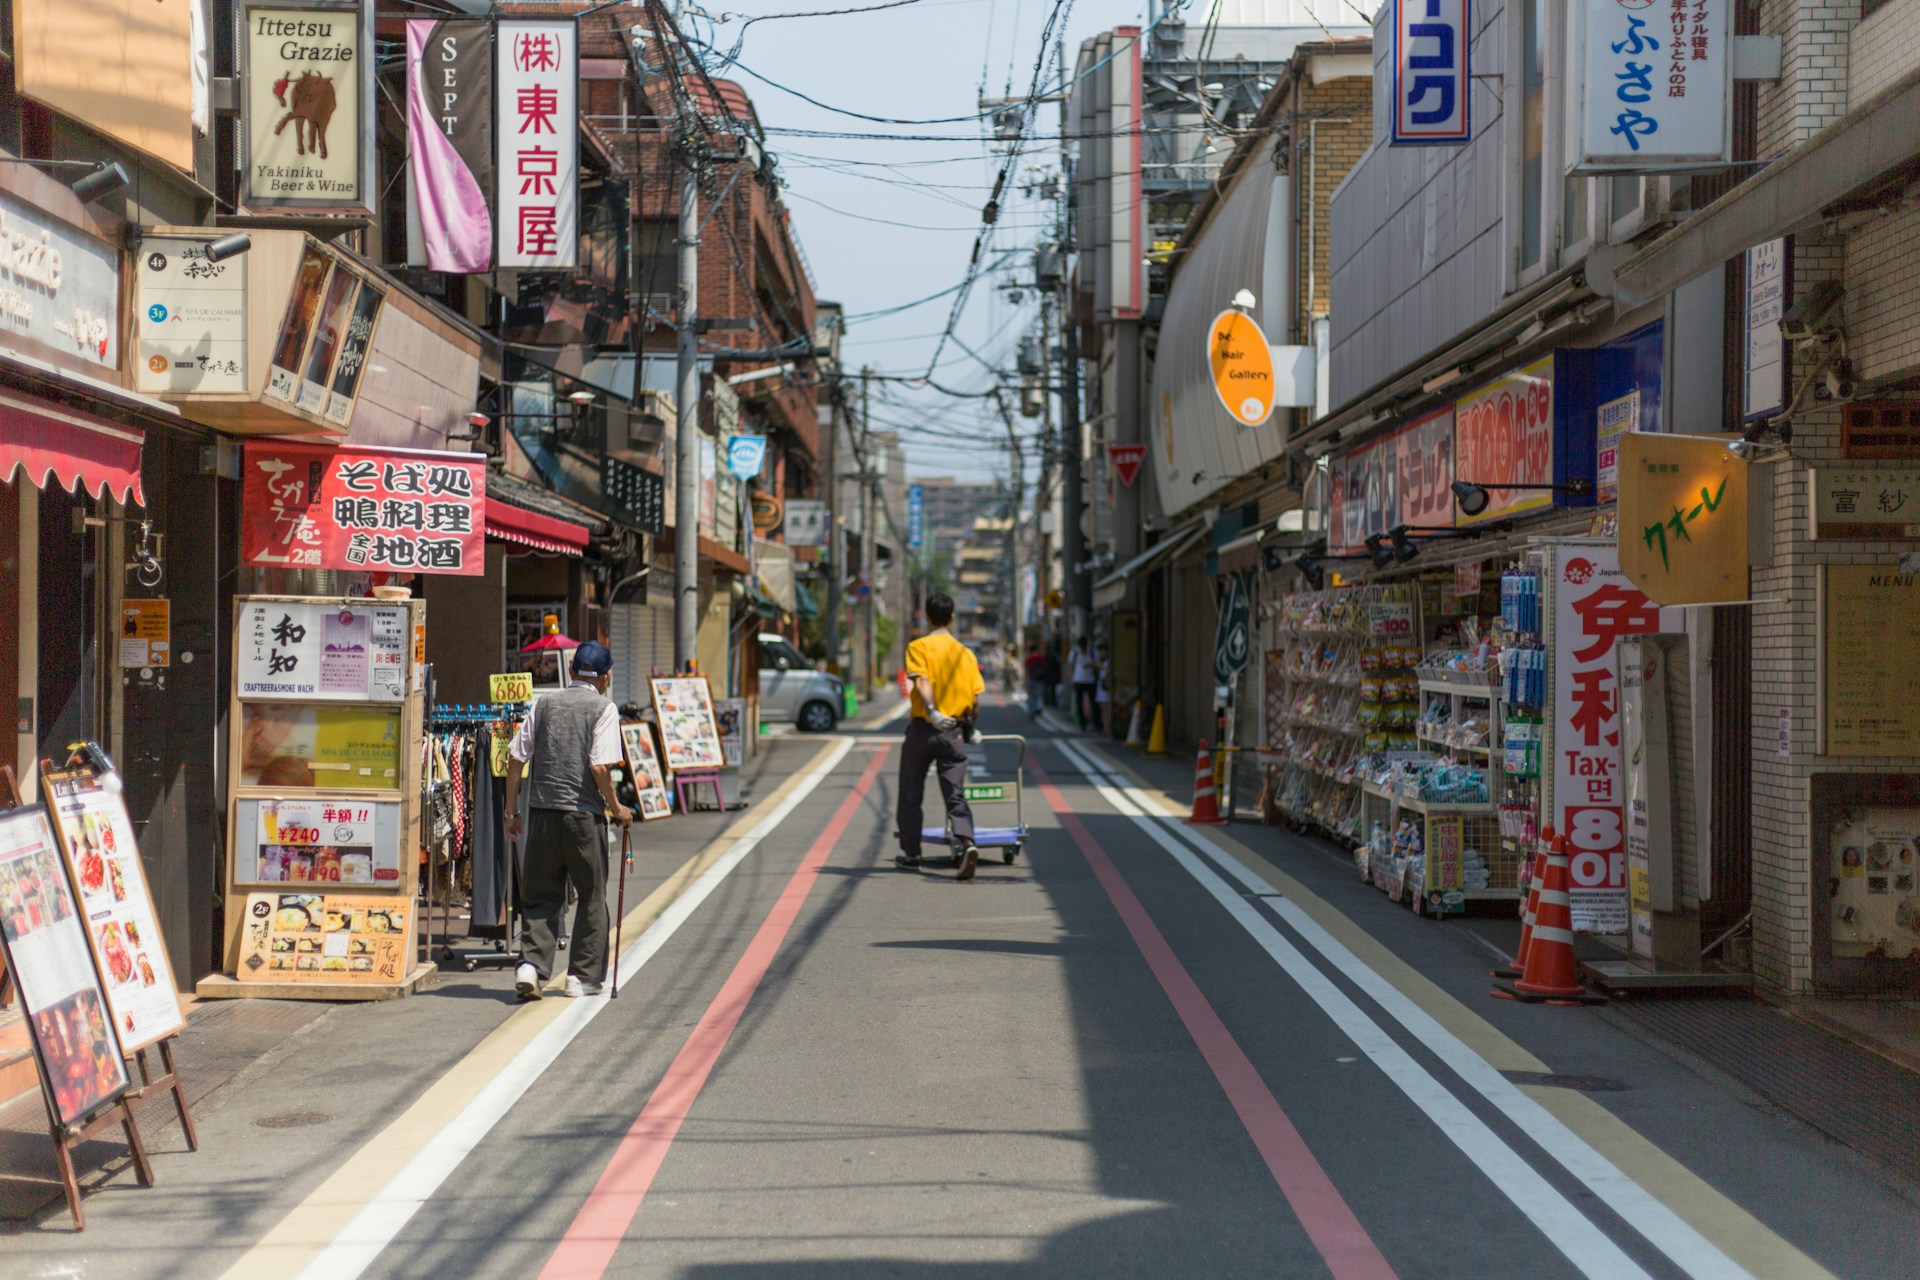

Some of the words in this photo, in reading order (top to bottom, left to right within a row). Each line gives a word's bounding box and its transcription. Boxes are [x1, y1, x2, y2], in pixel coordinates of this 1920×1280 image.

[256, 17, 332, 37] Ittetsu
[280, 41, 353, 61] Grazie
[1668, 0, 1688, 98] 手作りふとんの店
[441, 36, 458, 135] SEPT
[1609, 13, 1660, 151] ふさや
[257, 165, 323, 178] Yakiniku
[271, 179, 304, 191] Beer
[306, 181, 315, 190] &
[318, 180, 354, 192] Wine
[151, 256, 165, 268] 4F
[1755, 256, 1778, 280] クオーレ
[151, 307, 164, 319] 3F
[151, 358, 164, 369] 2F
[1221, 349, 1245, 360] Hair
[1229, 369, 1269, 382] Gallery
[336, 461, 473, 498] そば処
[1833, 474, 1920, 483] こだわりふと
[331, 497, 473, 533] 鴨料理
[1642, 474, 1729, 575] クオーレ
[292, 548, 321, 566] 2階
[346, 532, 371, 565] 全国
[369, 535, 463, 570] 地酒
[1869, 576, 1914, 587] MENU
[267, 612, 306, 676] 和知
[243, 683, 296, 693] CRAFTBEER&SMOKE
[297, 684, 315, 693] WACHI
[495, 682, 527, 701] 680
[255, 904, 269, 915] 2F
